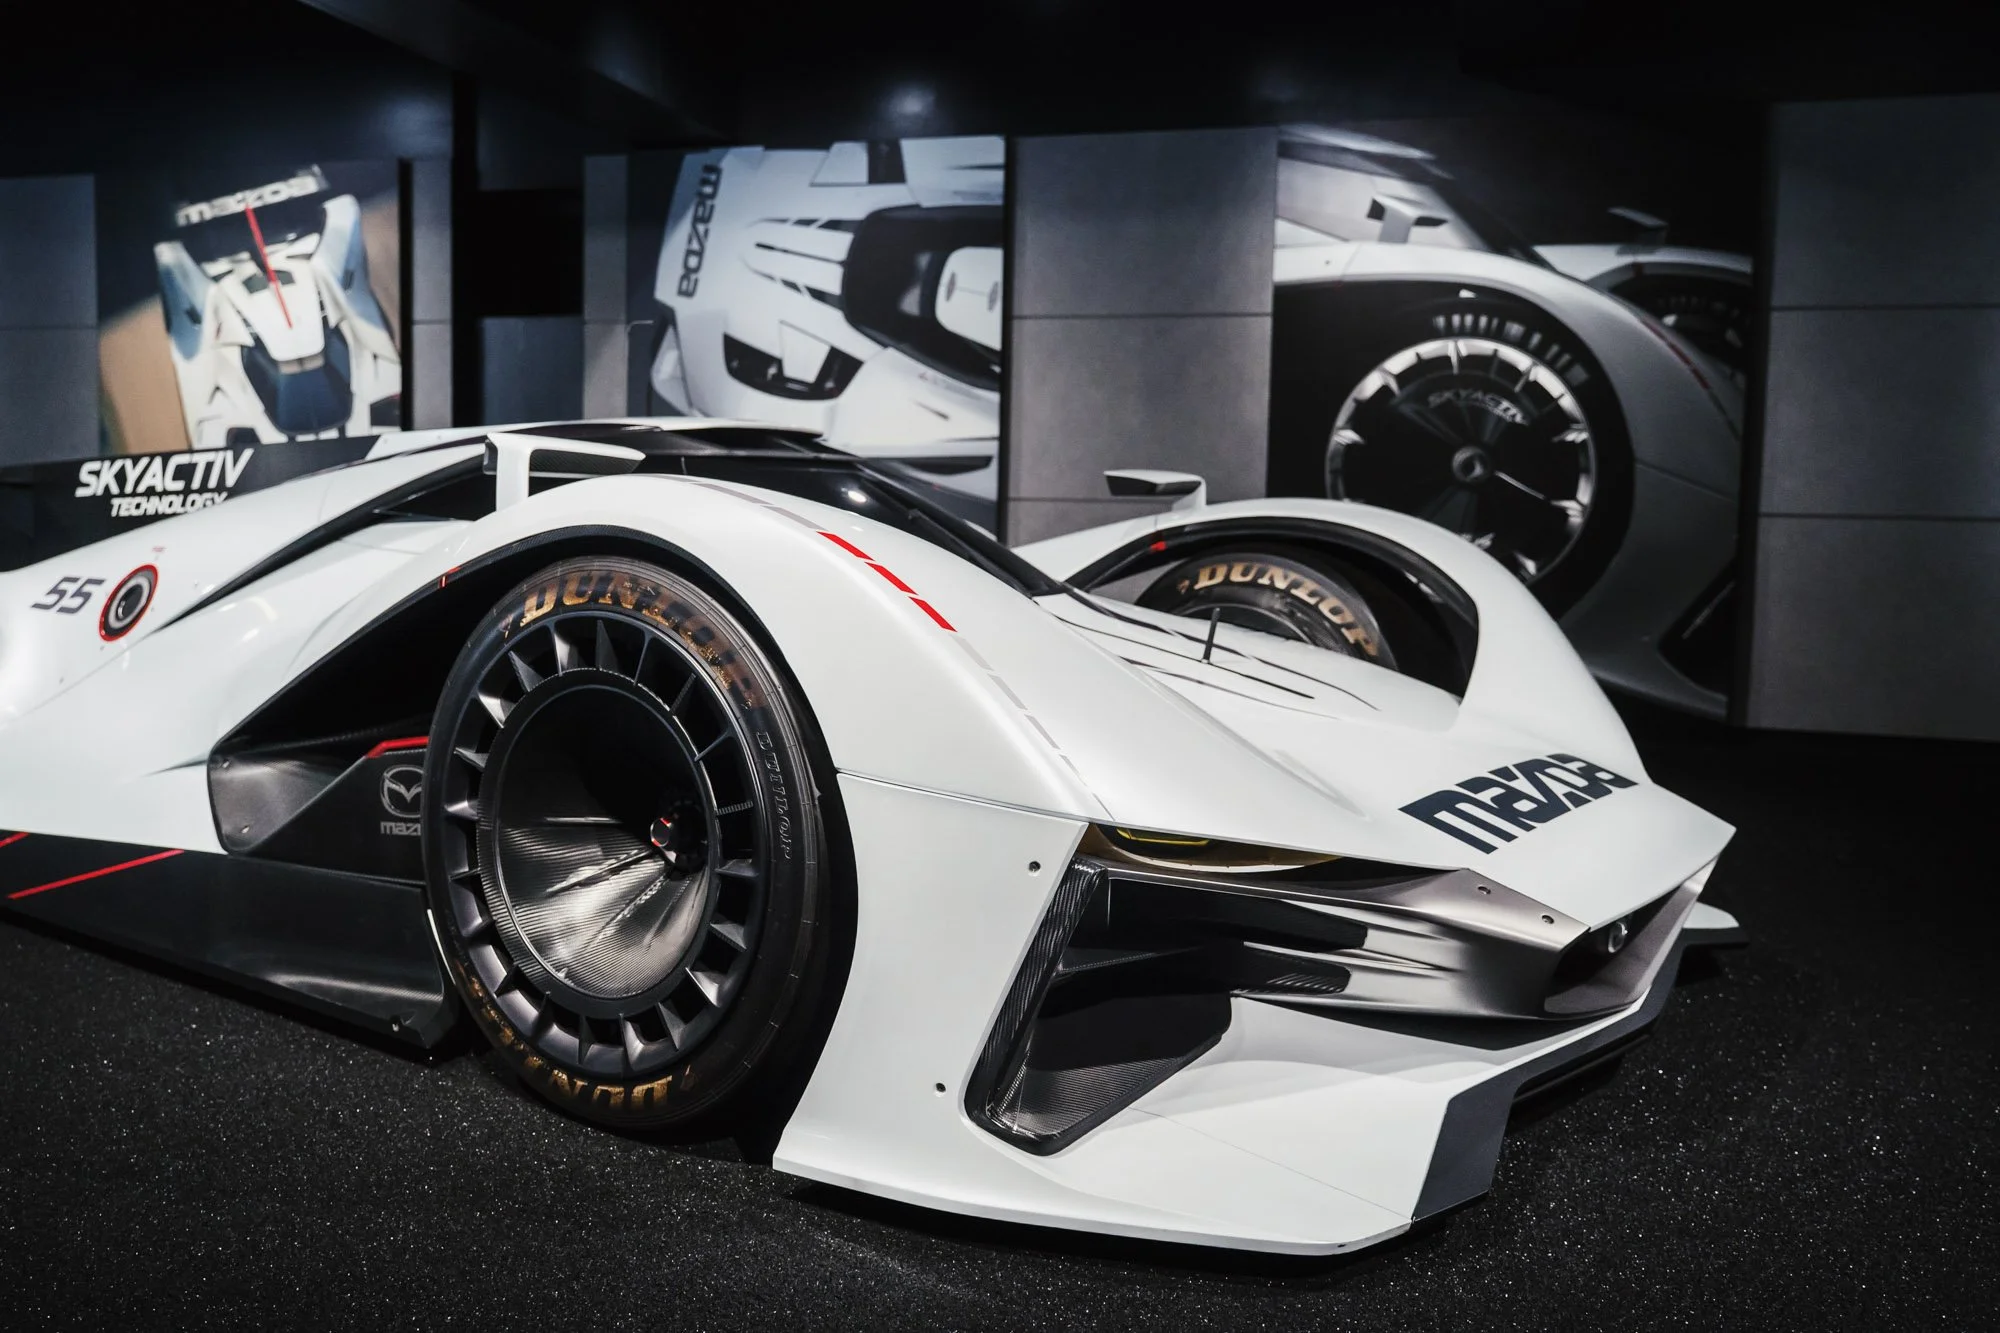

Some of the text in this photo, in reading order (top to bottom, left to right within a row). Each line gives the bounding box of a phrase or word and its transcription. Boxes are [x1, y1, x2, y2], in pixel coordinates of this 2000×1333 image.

[677, 164, 722, 298] mazda
[75, 448, 254, 497] SKYACTIV
[31, 576, 106, 614] 55
[1193, 561, 1378, 656] DUNLOP
[381, 822, 422, 836] maz
[1397, 753, 1638, 854] mazda
